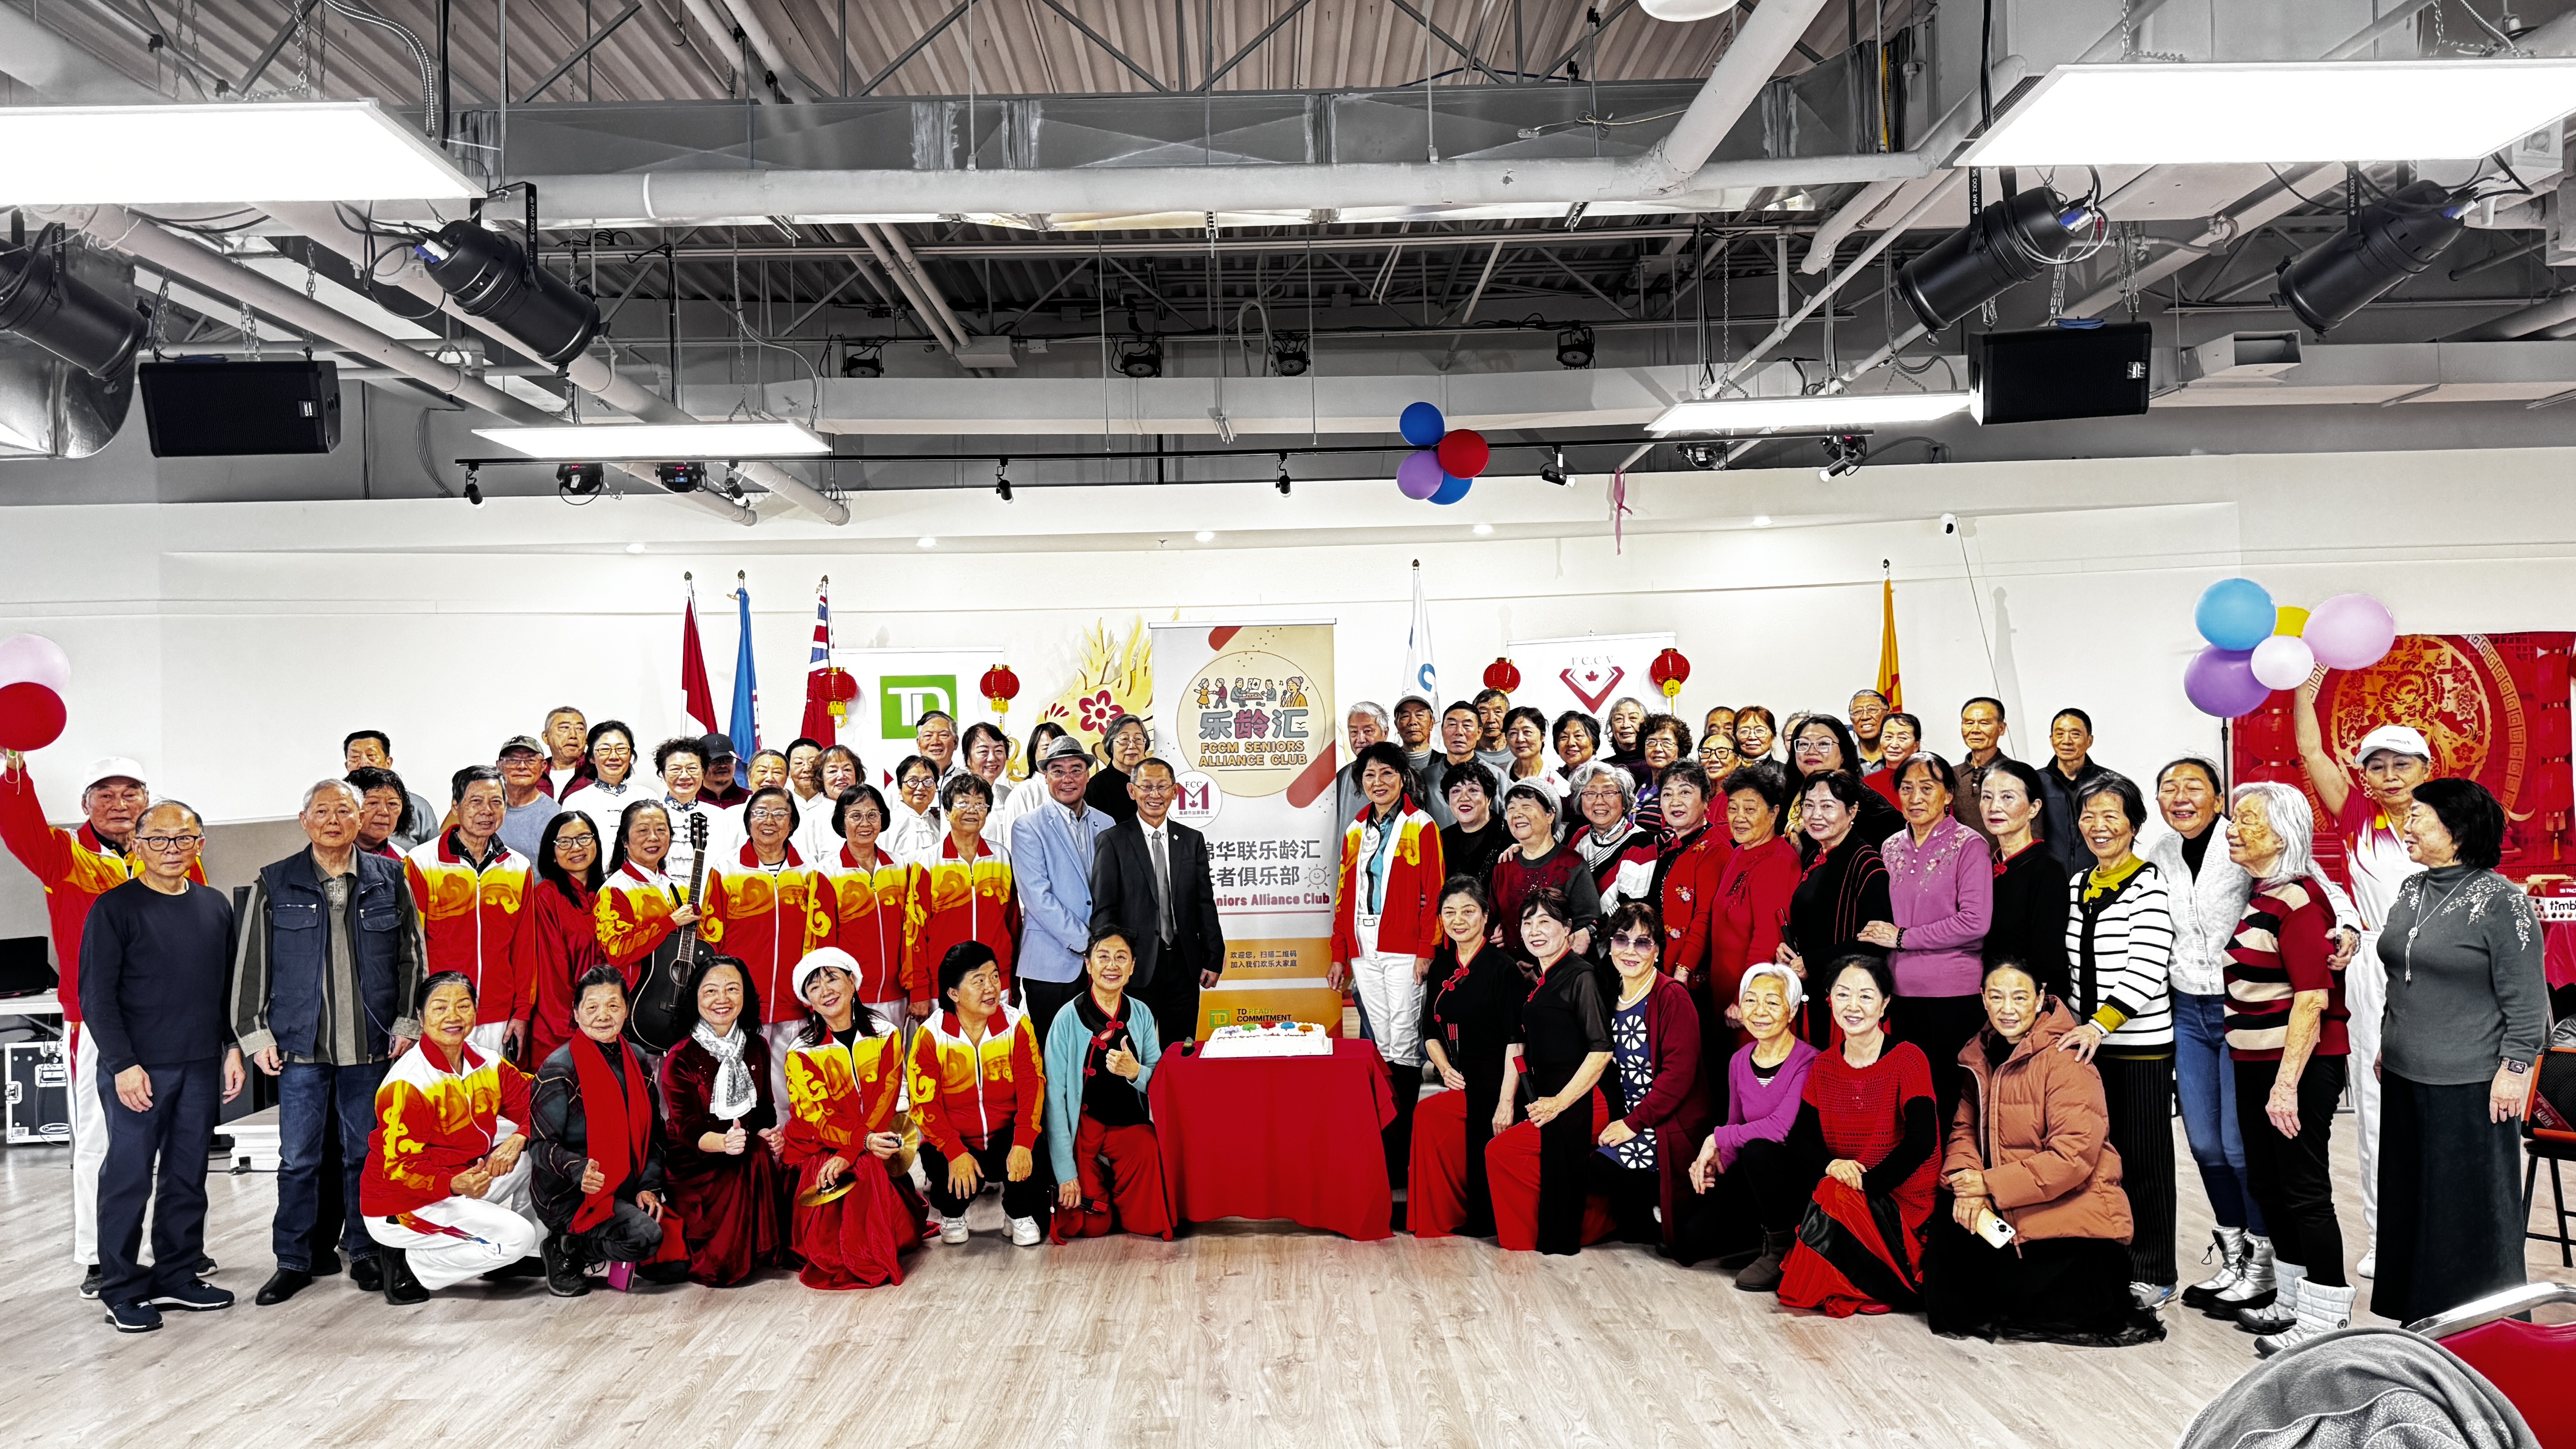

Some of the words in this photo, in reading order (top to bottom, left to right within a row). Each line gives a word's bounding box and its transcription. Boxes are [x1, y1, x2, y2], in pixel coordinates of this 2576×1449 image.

[887, 686, 950, 727] TD
[1198, 708, 1309, 740] 乐龄汇
[1201, 742, 1239, 754] FCCM
[1244, 740, 1305, 753] SENIORS
[1199, 754, 1265, 767] ALLIANCE
[1270, 754, 1307, 765] CLUB
[1251, 893, 1300, 906] Alliance
[1303, 892, 1330, 904] Club
[1230, 950, 1297, 959] 欢迎您，扫描二维码
[1230, 960, 1297, 969] 加入我们欢乐大家庭
[1211, 1013, 1228, 1025] TD
[1237, 1014, 1292, 1022] COMMITMENT
